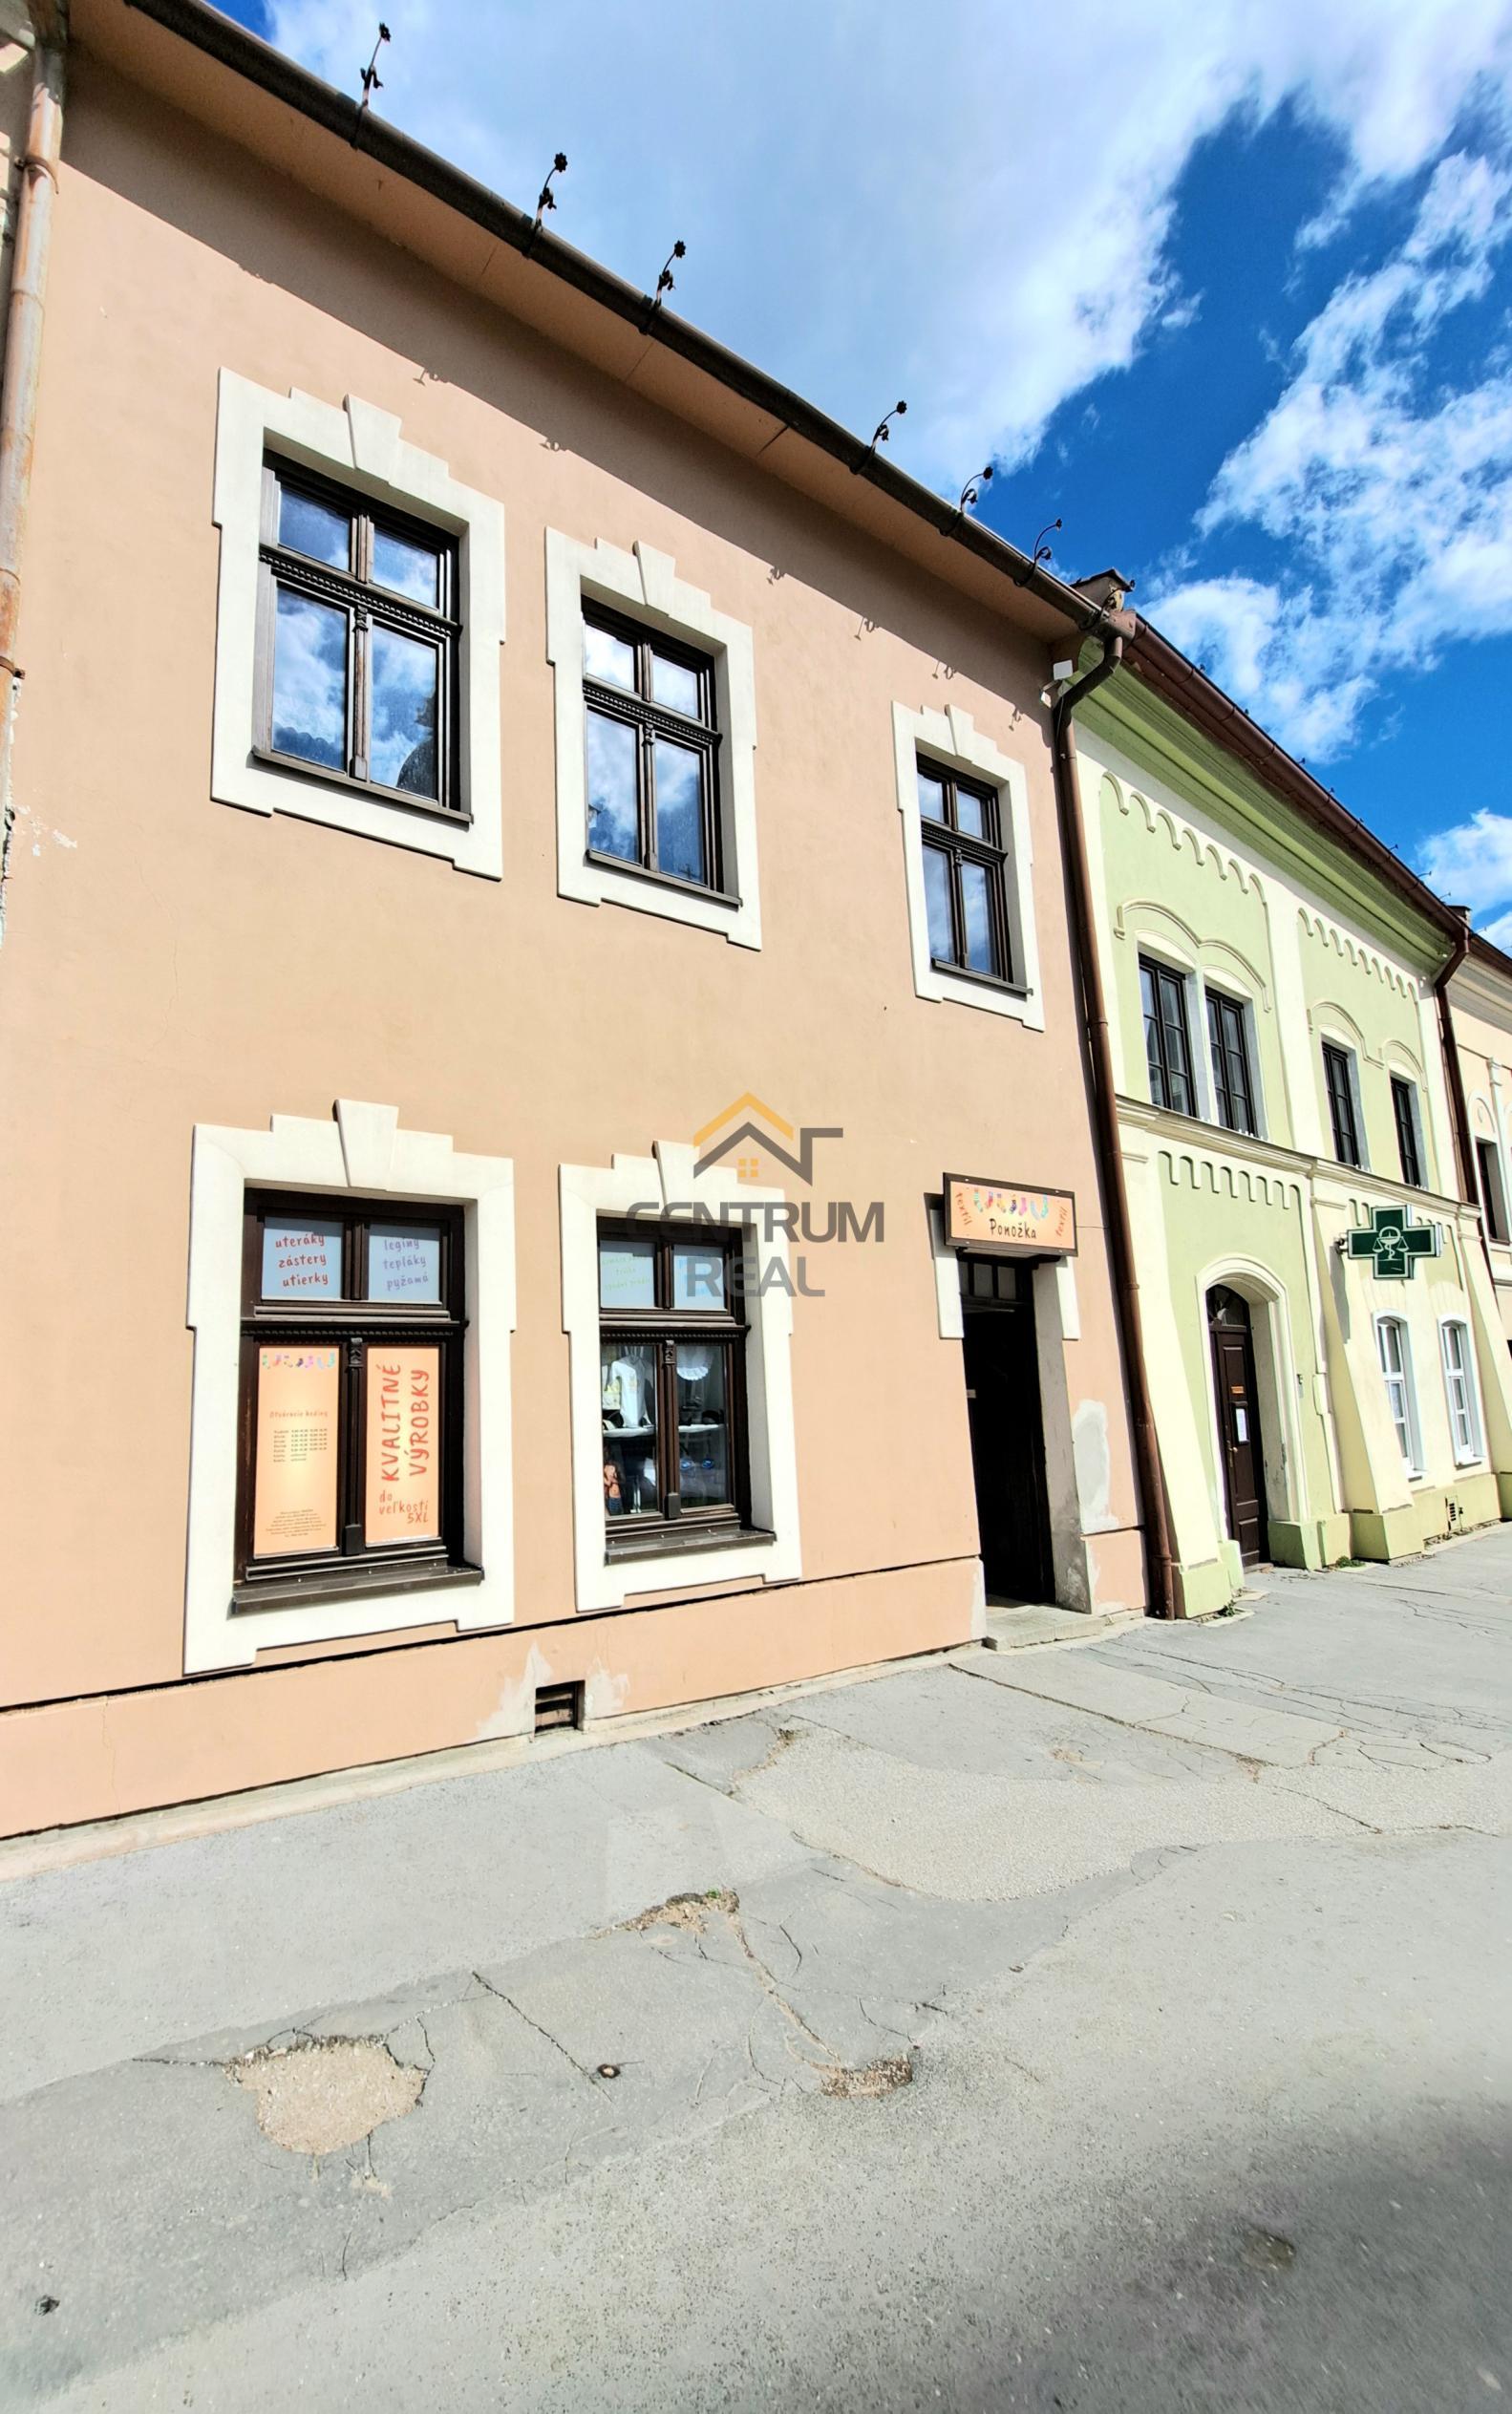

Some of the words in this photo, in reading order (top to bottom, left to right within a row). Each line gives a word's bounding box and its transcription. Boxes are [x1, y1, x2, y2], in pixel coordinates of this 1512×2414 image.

[989, 1218, 1037, 1239] Ponožka
[275, 1232, 325, 1248] uteráky
[278, 1254, 327, 1269] zástery
[383, 1254, 426, 1271] tepláky
[283, 1272, 329, 1287] utierky
[375, 1364, 401, 1482] KVALITNÉ
[404, 1369, 430, 1477] VÝROBKY
[379, 1490, 393, 1503] do
[407, 1512, 429, 1524] 5XL
